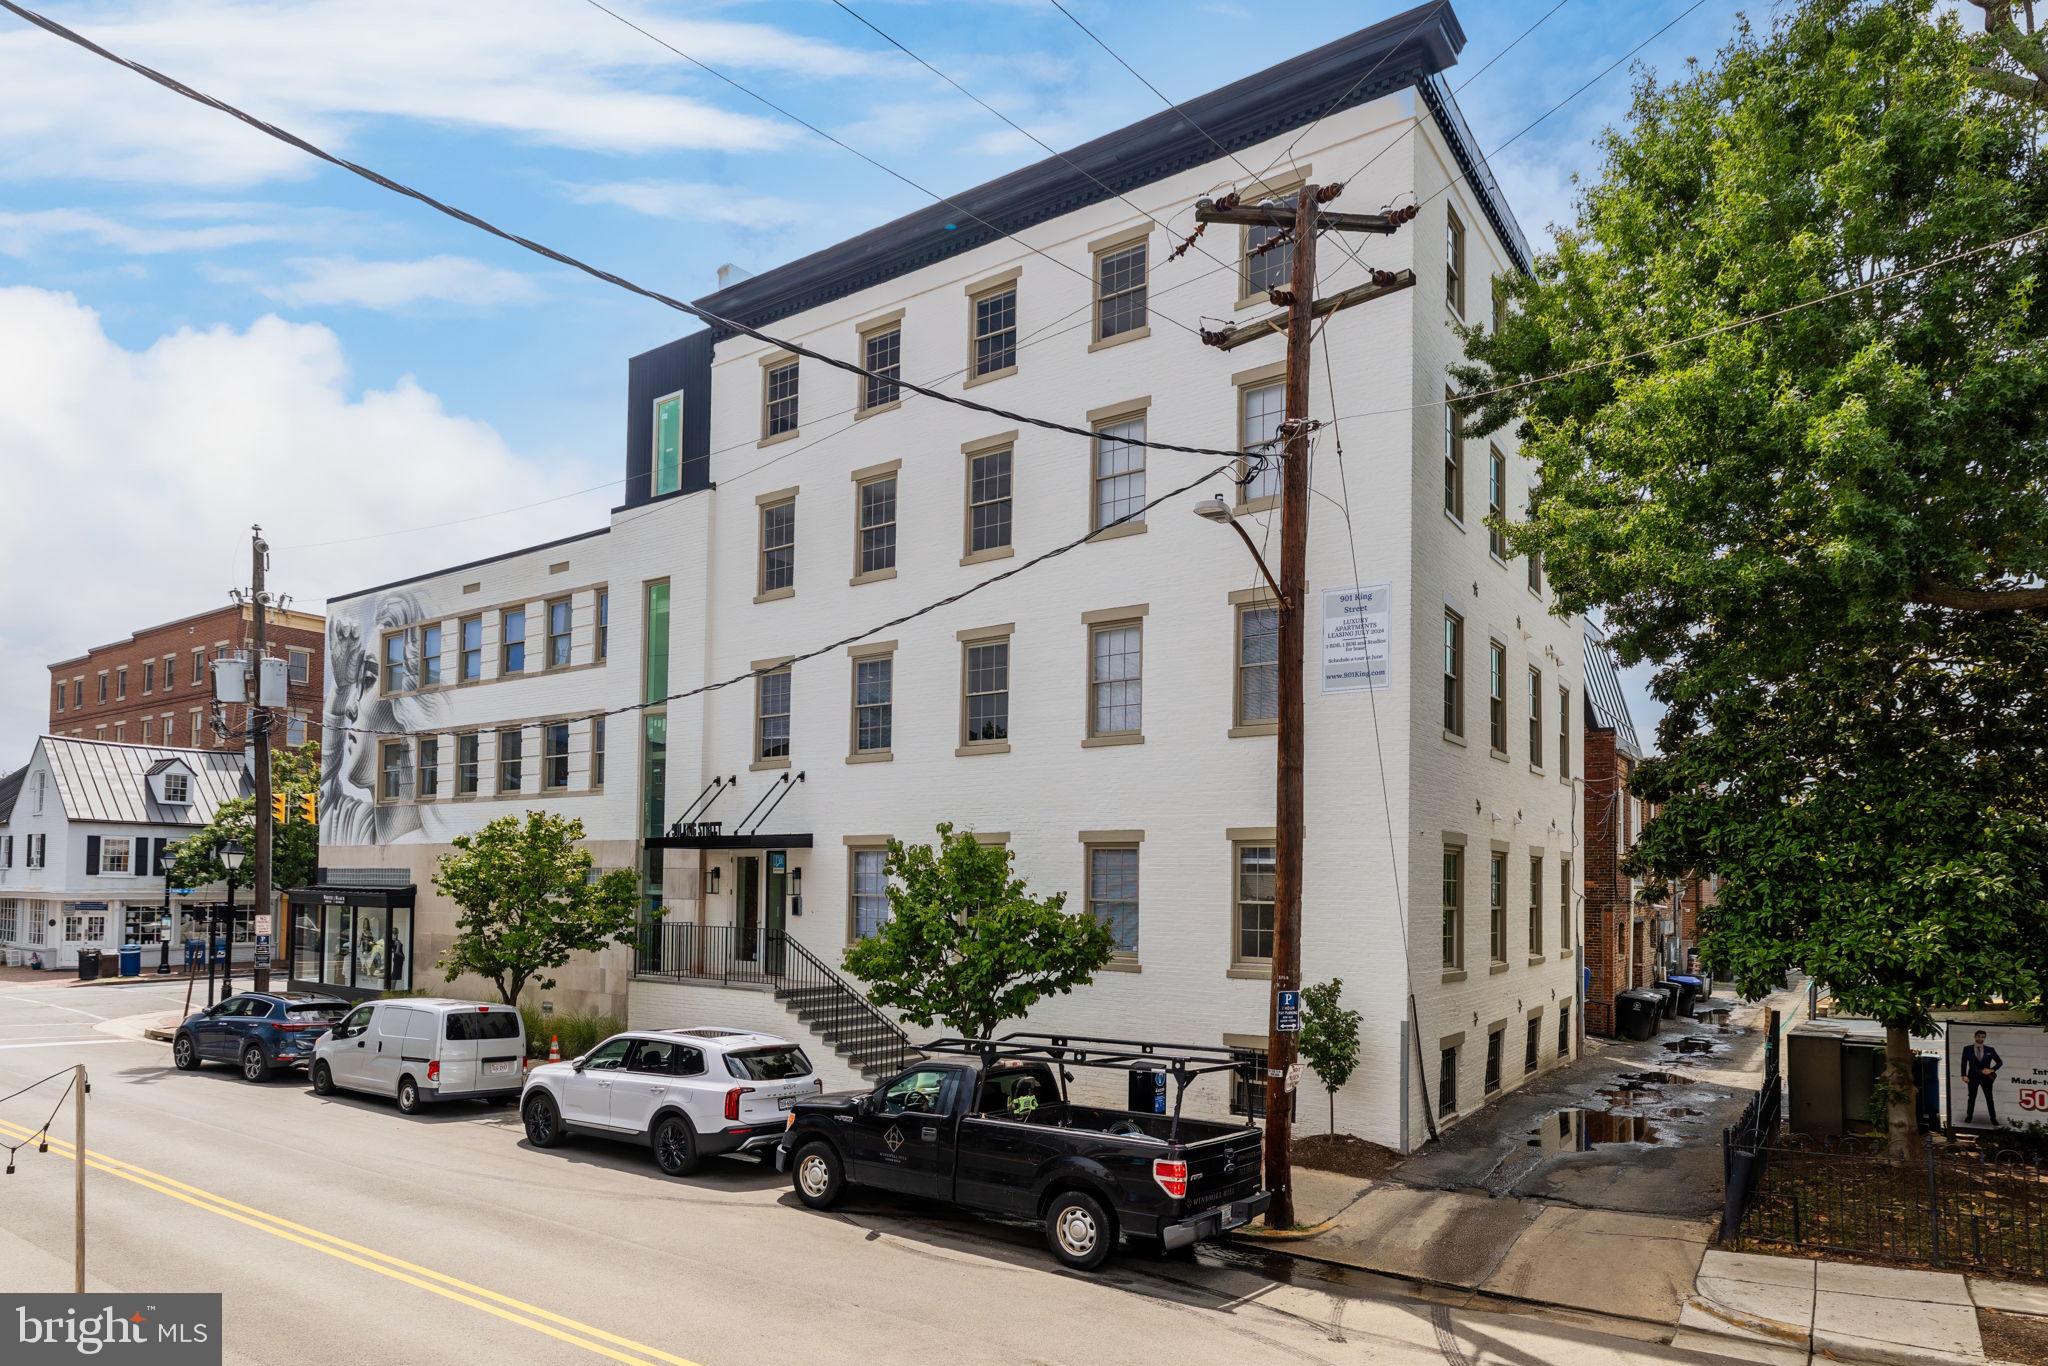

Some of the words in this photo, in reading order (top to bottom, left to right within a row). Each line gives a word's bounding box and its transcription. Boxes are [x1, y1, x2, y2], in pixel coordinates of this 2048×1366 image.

[1355, 593, 1373, 601] King
[1344, 605, 1368, 613] Street
[1343, 617, 1369, 625] LUXURY
[1335, 622, 1378, 632] APARTMENTS
[1354, 629, 1370, 637] JULY
[1326, 669, 1386, 680] www.901King.com
[698, 821, 723, 837] STREET
[1285, 994, 1292, 1005] P
[2011, 1077, 2048, 1085] Made-t
[2019, 1089, 2048, 1112] 50
